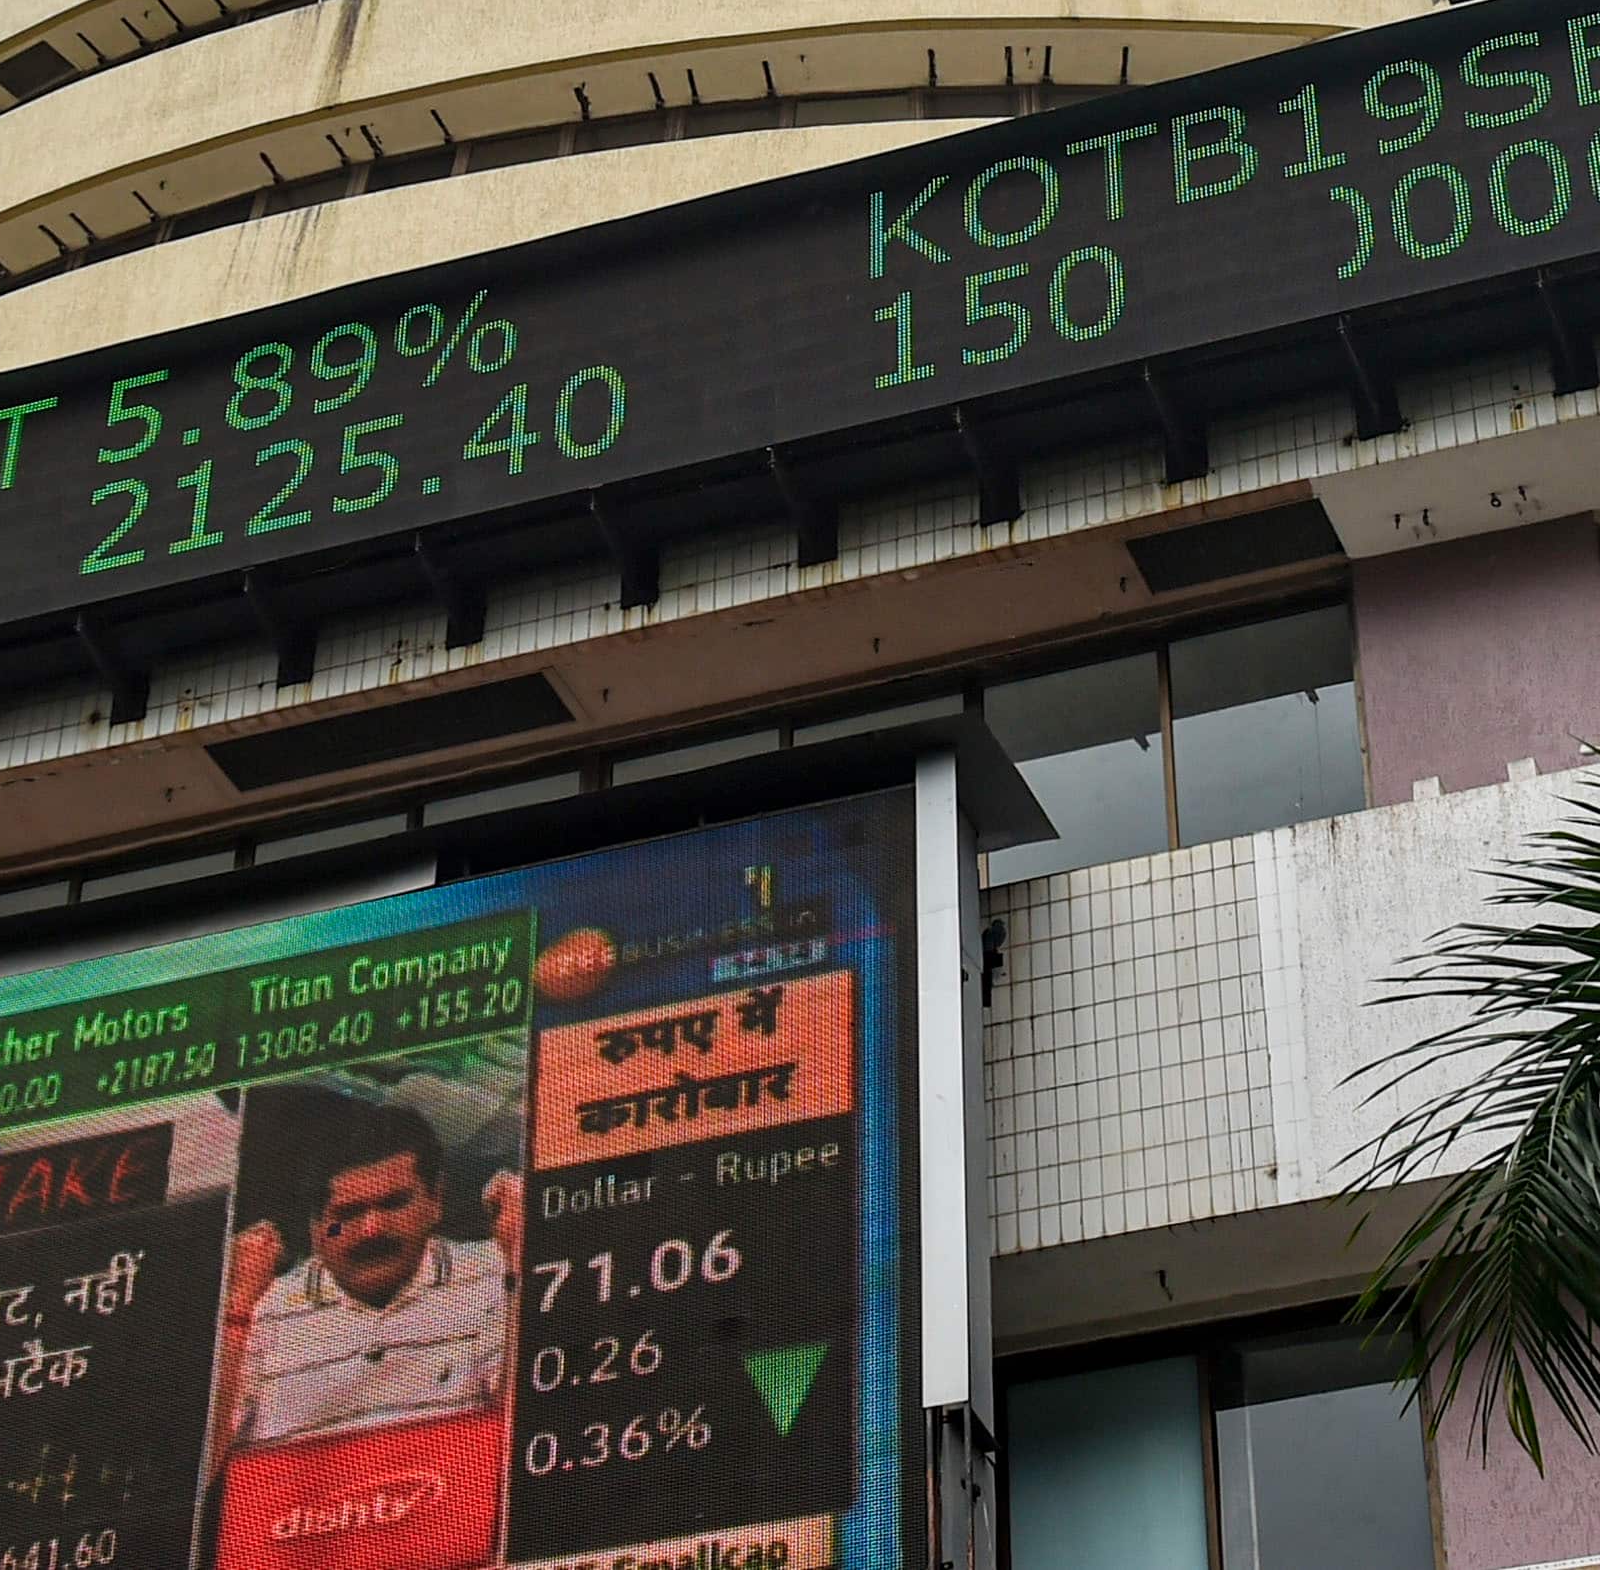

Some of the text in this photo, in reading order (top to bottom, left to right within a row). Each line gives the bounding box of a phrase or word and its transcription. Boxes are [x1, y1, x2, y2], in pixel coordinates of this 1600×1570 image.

[97, 289, 519, 464] 5.89%
[80, 364, 627, 574] 2125.40
[249, 935, 513, 1016] Titan Company
[74, 1002, 189, 1054] Motors
[237, 977, 523, 1069] 1308.40 +155.20
[576, 1060, 797, 1136] कारोबार
[542, 1173, 657, 1221] Dollar
[715, 1141, 840, 1187] Rupee
[64, 1249, 145, 1316] नहीं
[532, 1229, 743, 1313] 71.06
[532, 1330, 663, 1393] 0.26
[525, 1404, 712, 1475] 0.36%
